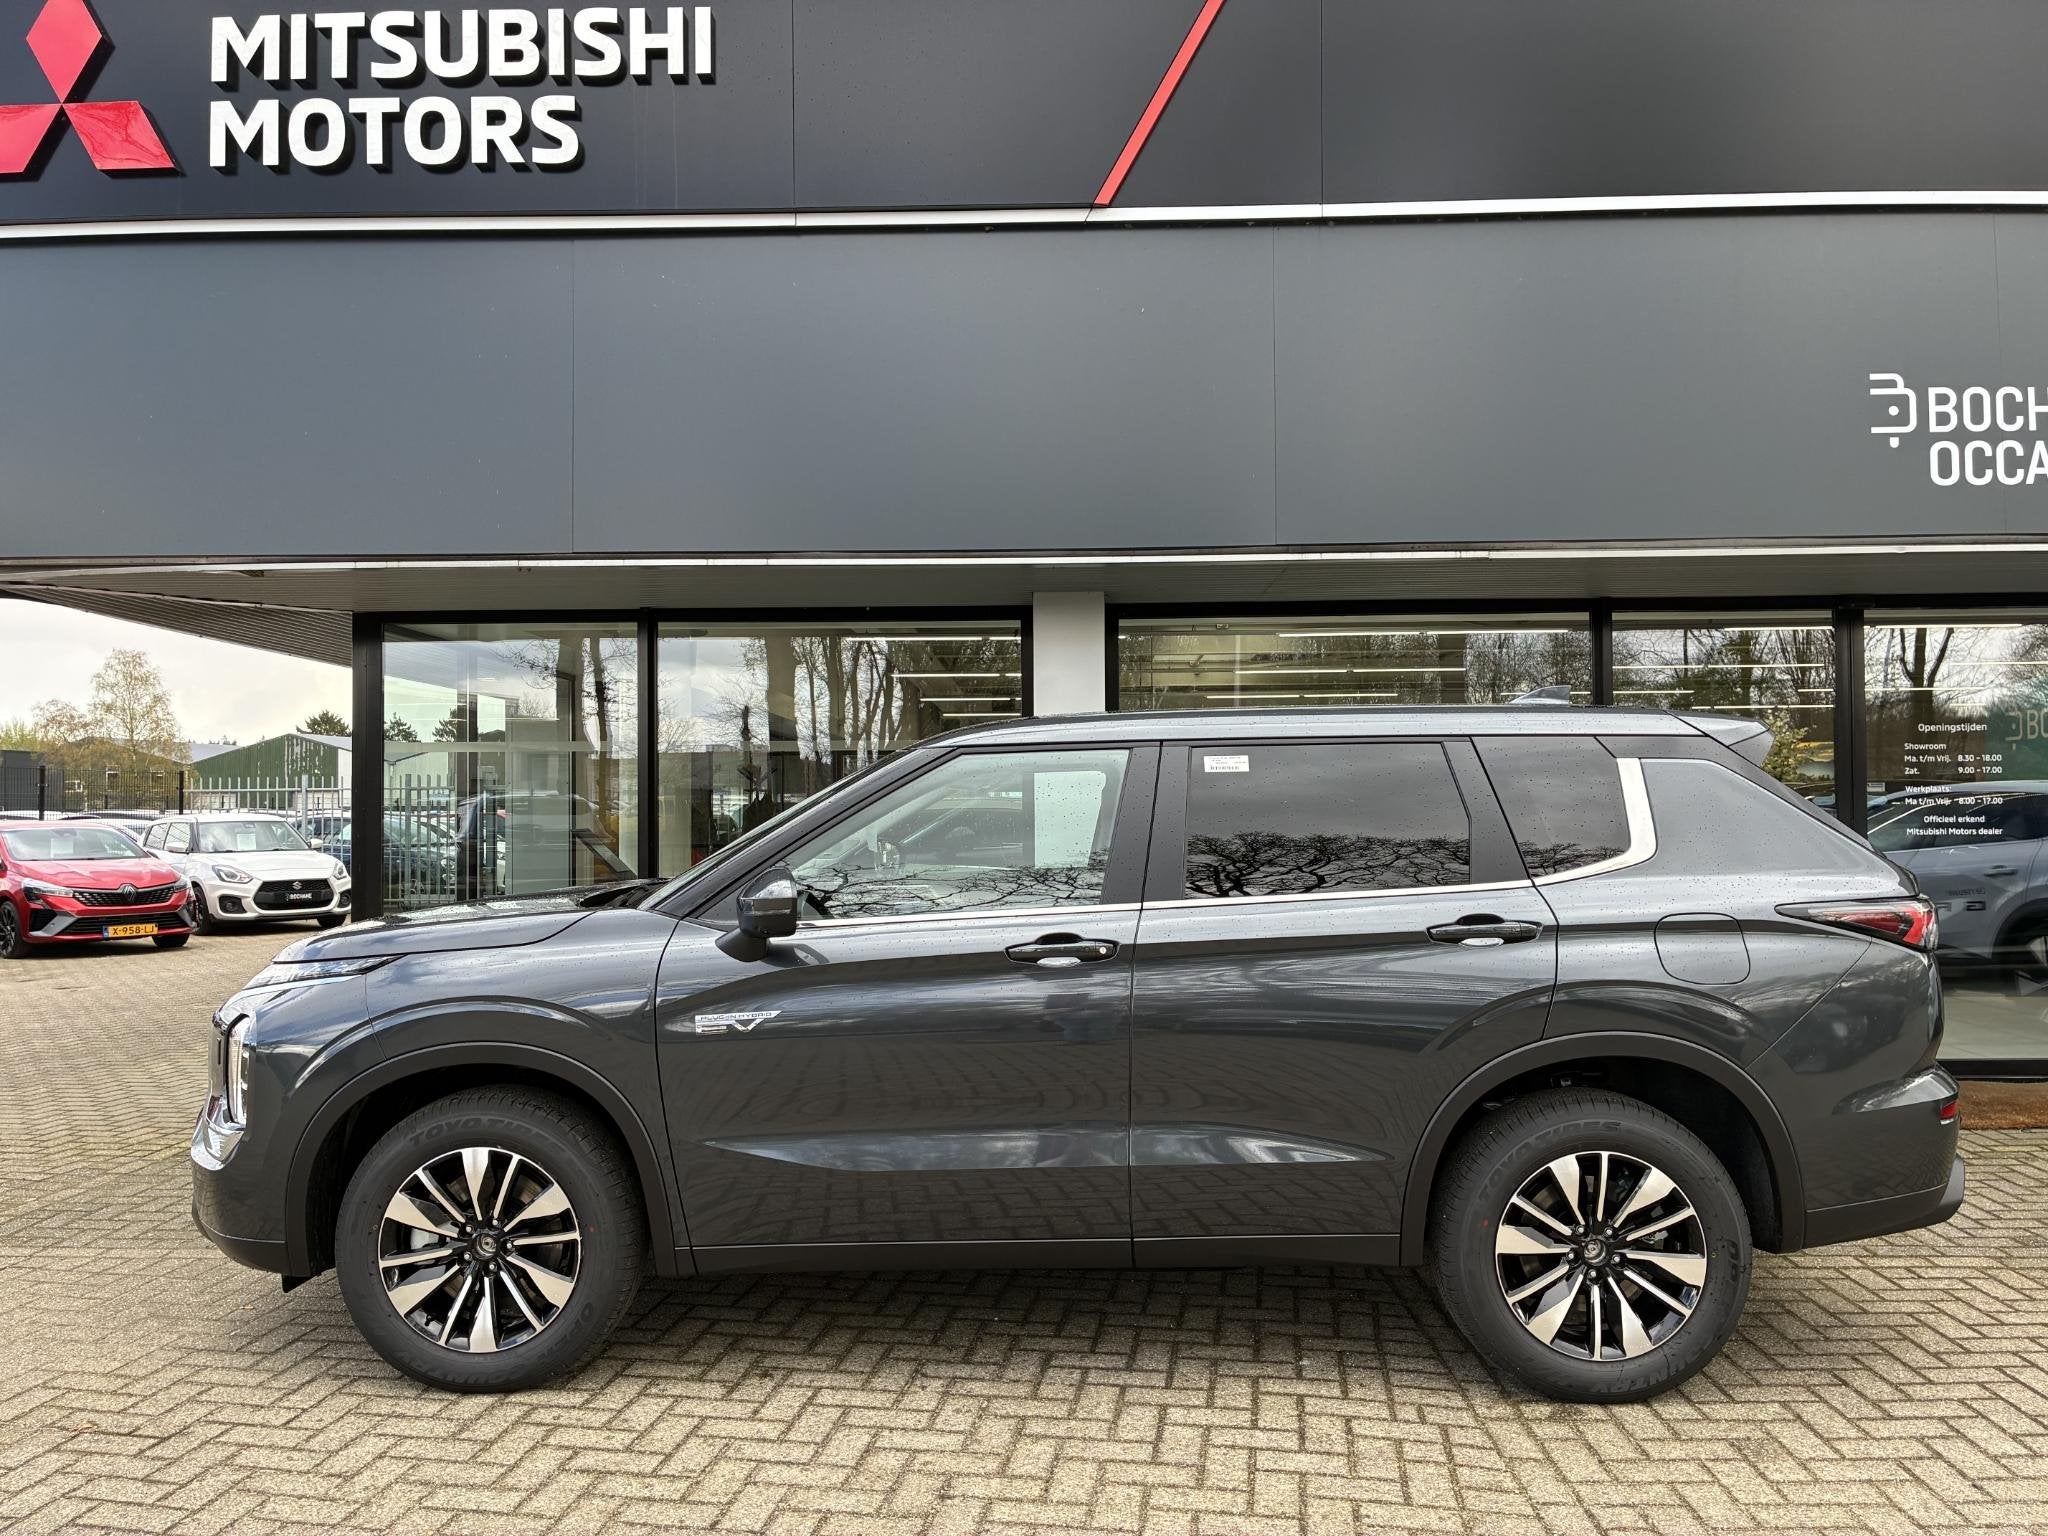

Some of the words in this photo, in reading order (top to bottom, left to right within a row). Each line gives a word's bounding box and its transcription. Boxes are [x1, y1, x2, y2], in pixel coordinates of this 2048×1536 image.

[210, 6, 713, 83] MITSUBISHI
[209, 95, 581, 168] MOTORS
[1929, 440, 2048, 486] OCCA
[1918, 723, 1987, 733] Openingstijden
[1904, 755, 1918, 763] Ma.
[1920, 754, 1935, 762] t/m
[1958, 754, 1974, 762] 8.30
[1905, 797, 1917, 805] Ma
[1924, 815, 1956, 823] Officieel
[1958, 815, 1985, 823] erkend
[1978, 827, 2003, 835] dealer
[112, 925, 154, 936] X-958-LJ
